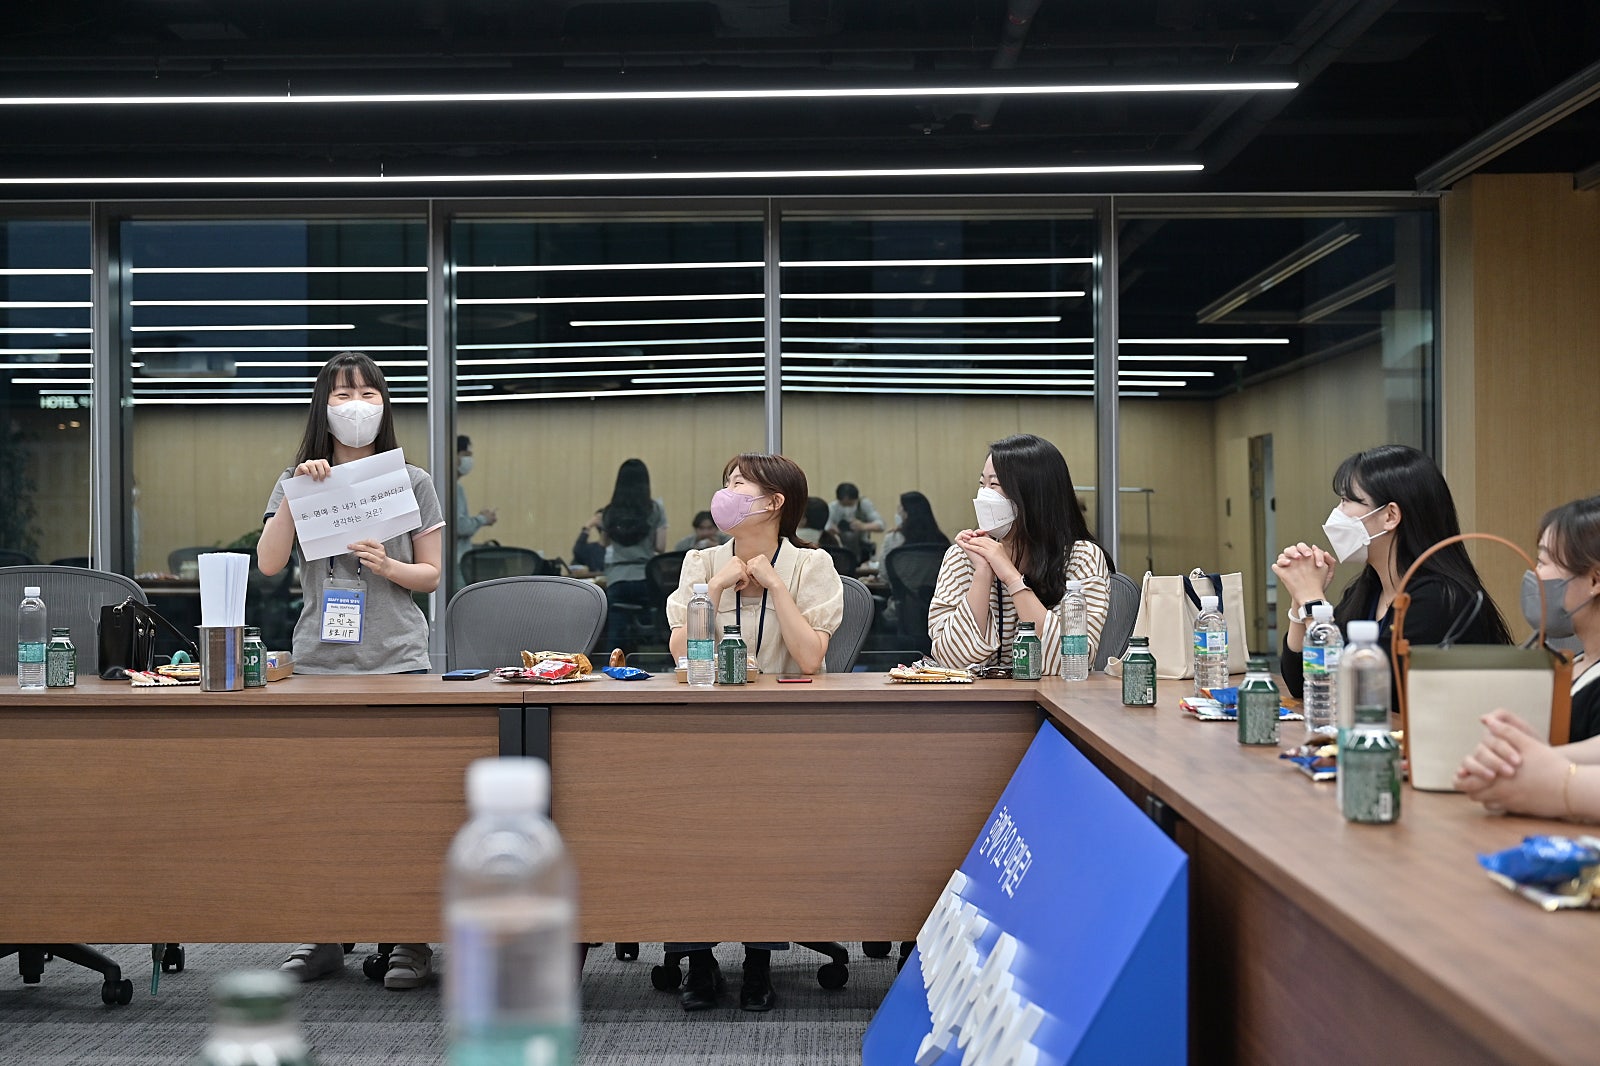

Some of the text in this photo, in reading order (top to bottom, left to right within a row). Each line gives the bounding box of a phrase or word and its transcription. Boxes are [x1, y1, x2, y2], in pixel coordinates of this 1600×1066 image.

[40, 396, 79, 409] HOTEL
[313, 508, 328, 518] 명예
[332, 505, 340, 514] 중
[342, 501, 357, 510] 내가
[370, 486, 404, 503] 중요하다고
[333, 507, 382, 528] 생각하는 것은?
[979, 805, 1018, 868] 함께가요
